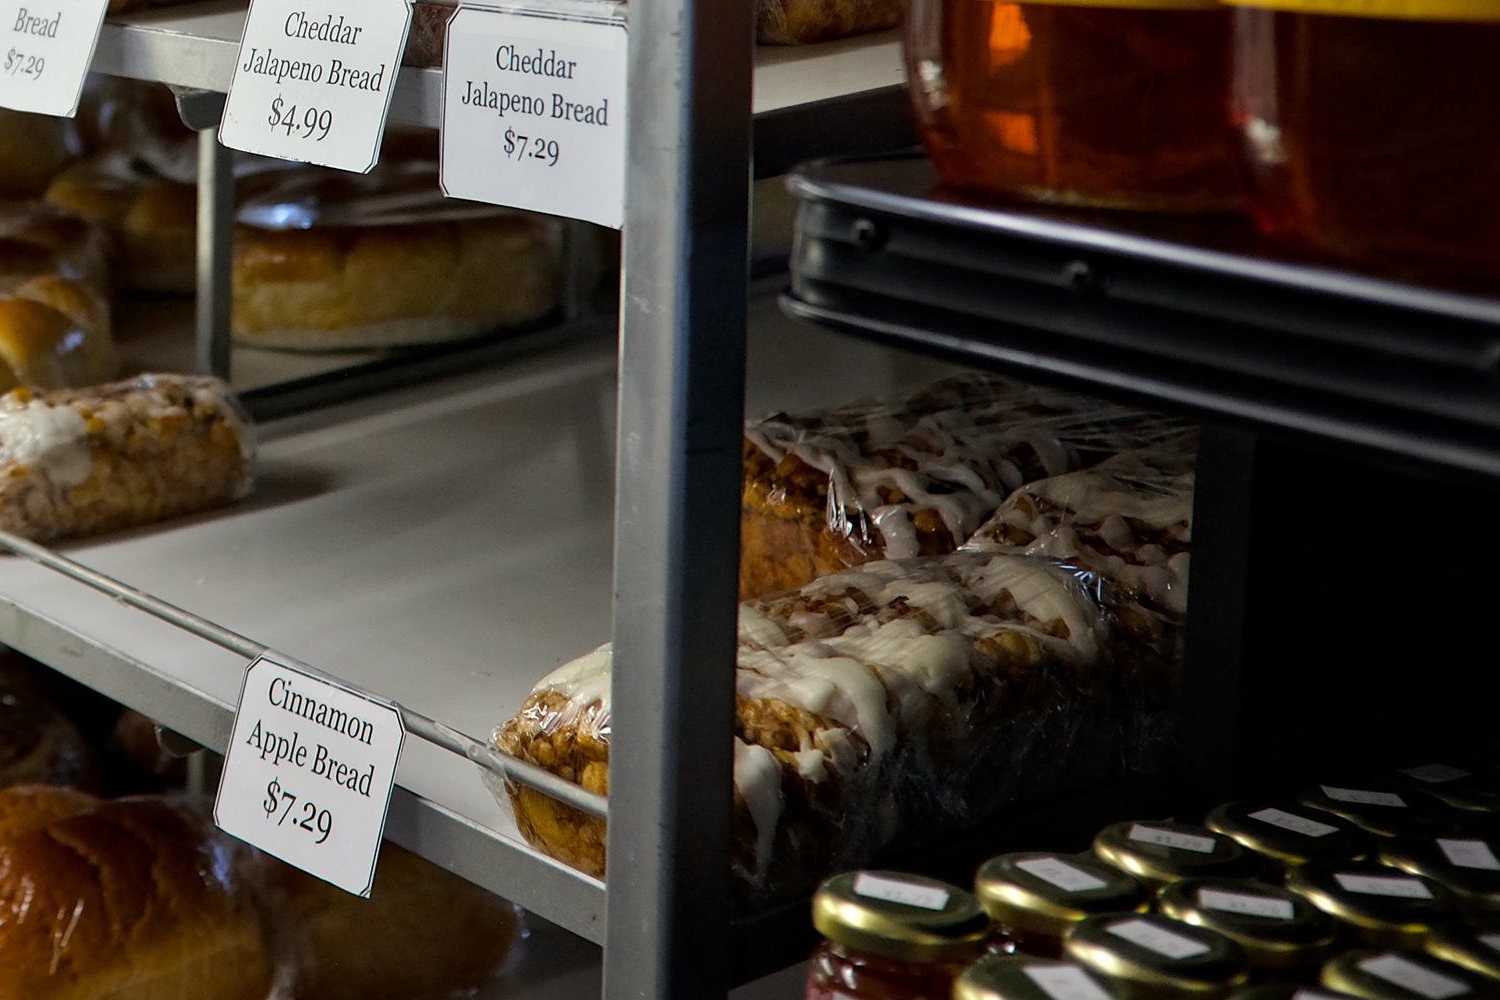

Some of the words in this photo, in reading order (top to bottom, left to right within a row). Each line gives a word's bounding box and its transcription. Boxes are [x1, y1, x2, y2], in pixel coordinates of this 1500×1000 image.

[12, 8, 62, 38] Bread
[284, 12, 362, 45] Cheddar
[3, 47, 45, 81] $7.29
[243, 48, 323, 85] Jalapeno
[326, 58, 385, 92] Bread
[496, 45, 577, 80] Cheddar
[267, 92, 333, 142] $4.99
[461, 81, 544, 117] Jalapeno
[551, 93, 609, 126] Bread
[503, 126, 560, 168] $7.29
[268, 677, 375, 746] Cinnamon
[246, 719, 308, 768] Apple
[310, 744, 376, 798] Bread
[263, 776, 333, 844] $7.29
